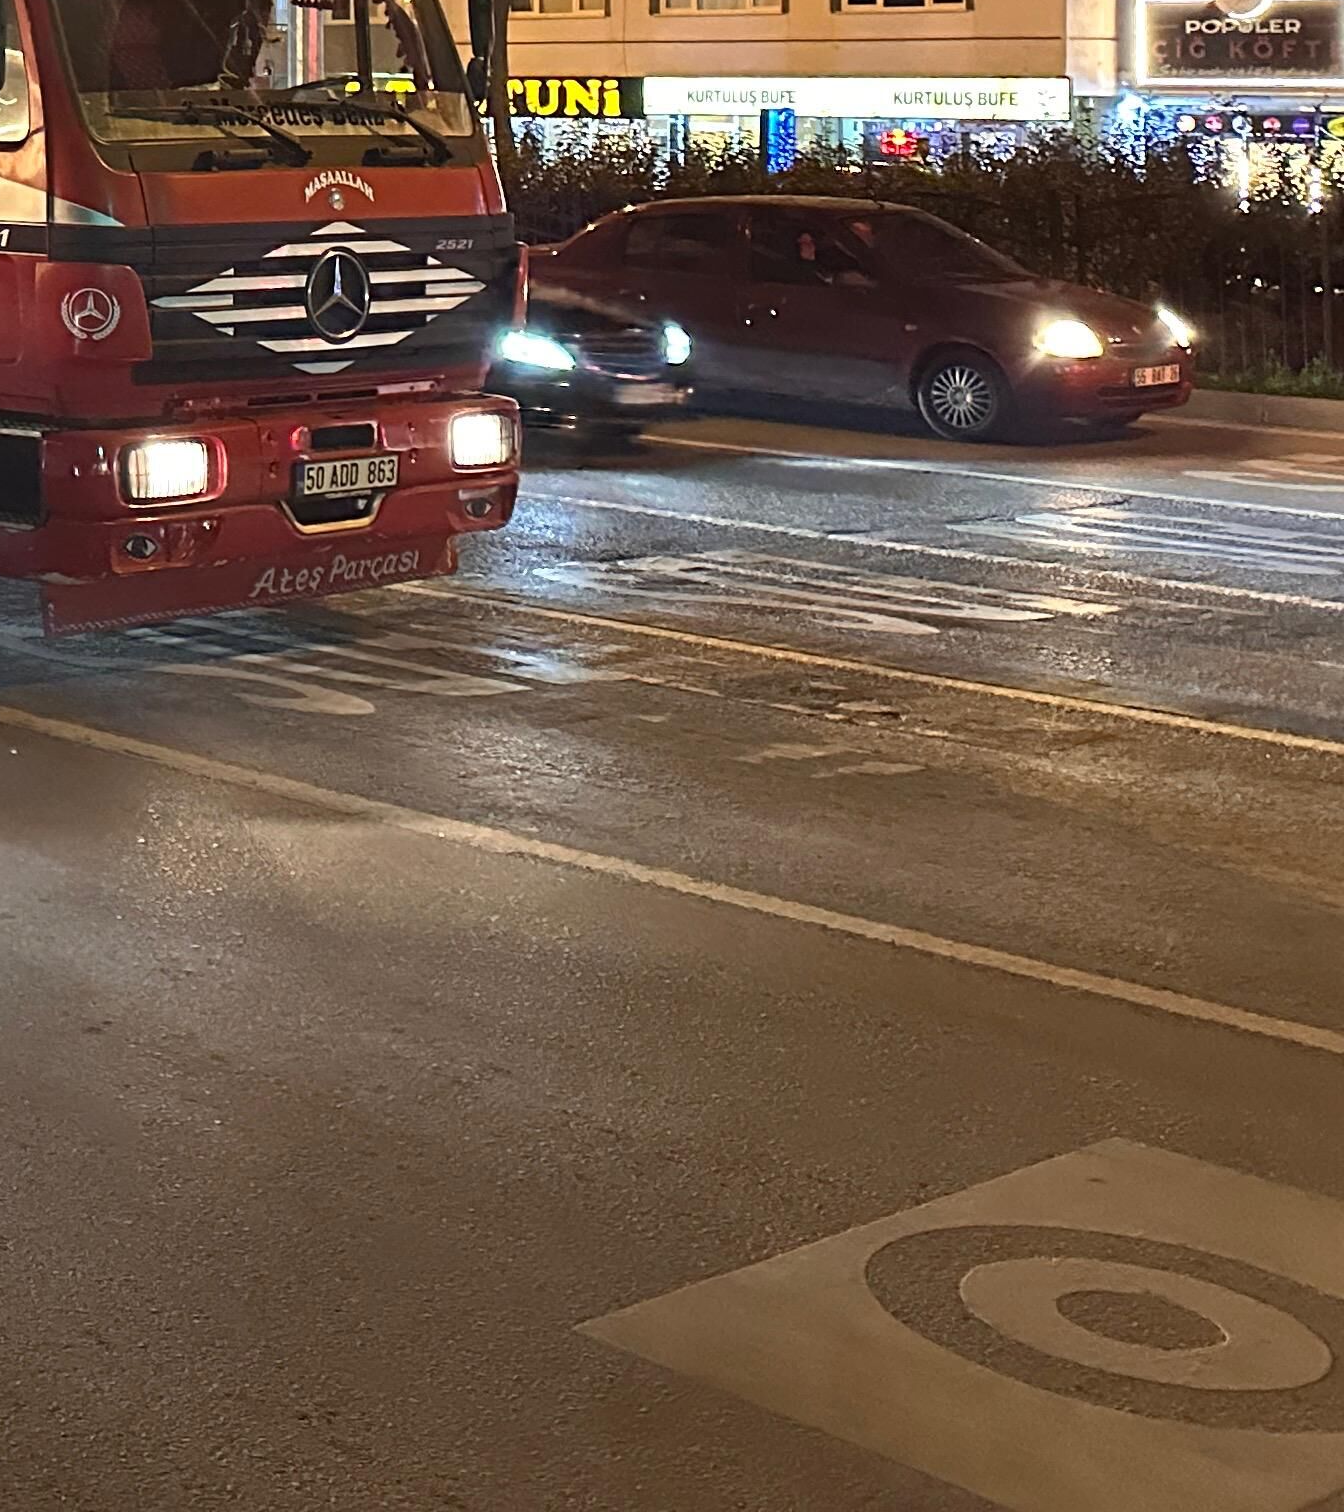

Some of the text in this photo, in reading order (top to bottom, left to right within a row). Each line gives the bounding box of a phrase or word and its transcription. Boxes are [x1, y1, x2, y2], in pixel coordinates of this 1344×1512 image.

[687, 90, 757, 107] KURTULUŞ
[893, 91, 973, 108] KURTULUŞ
[436, 238, 474, 250] 2521
[305, 459, 396, 491] 50 ADD 863
